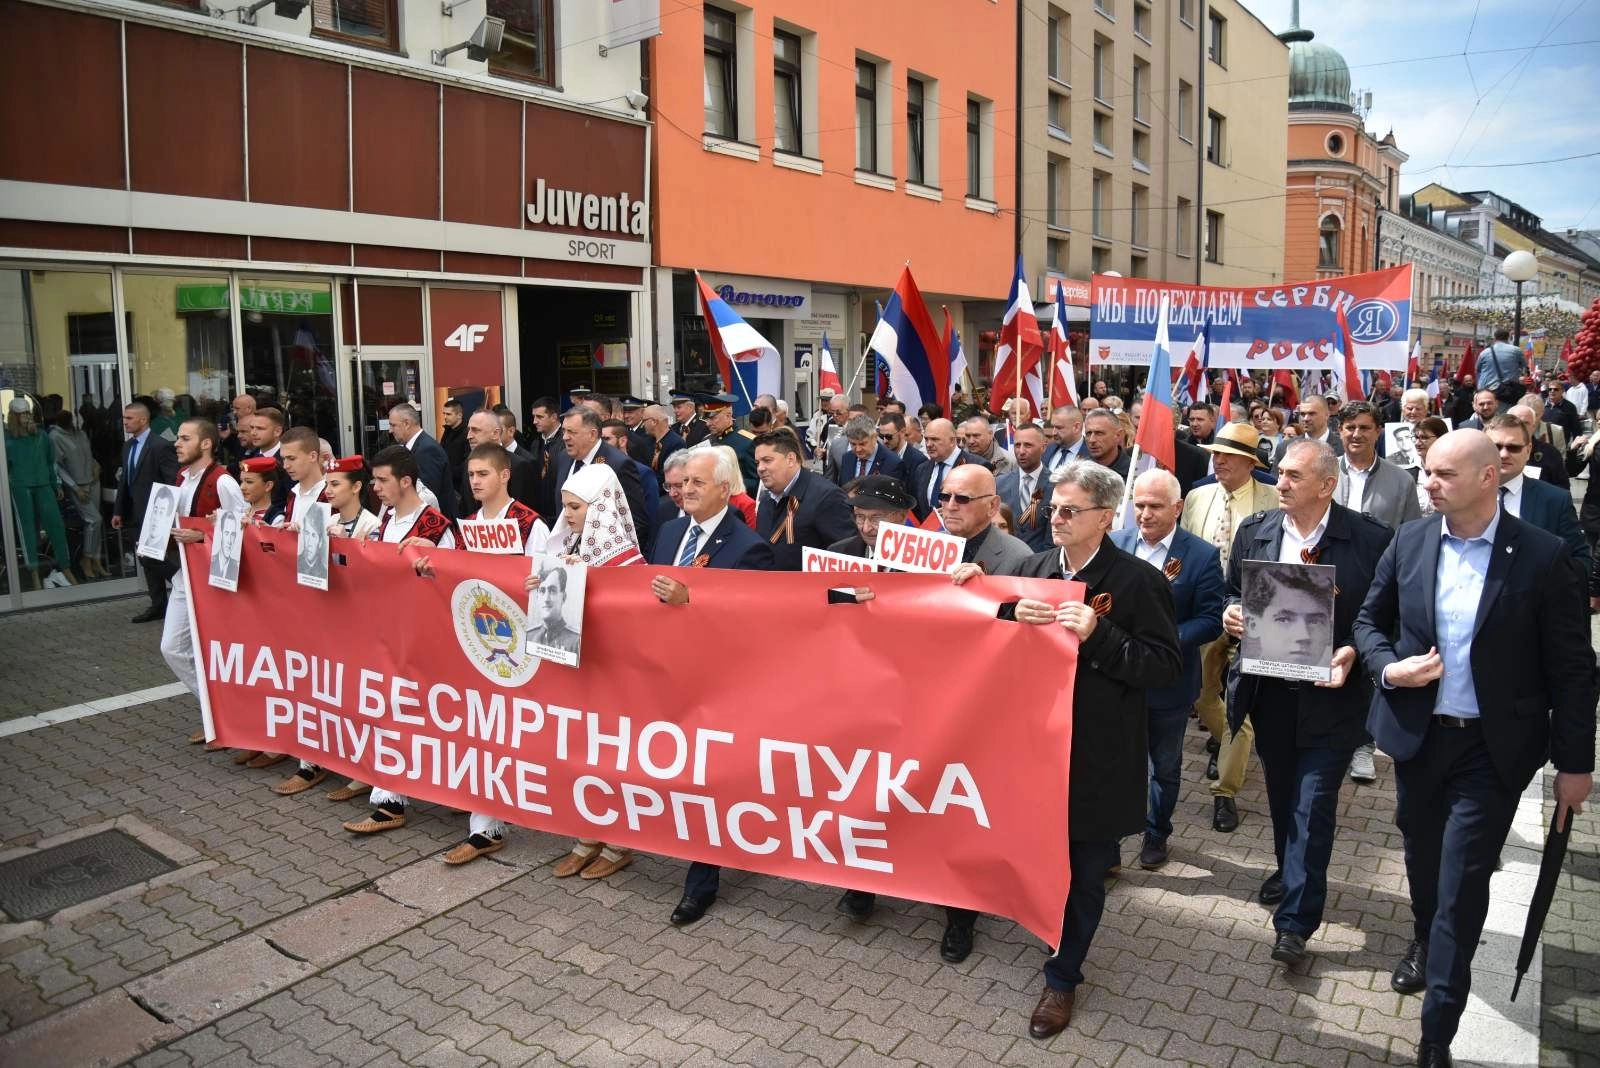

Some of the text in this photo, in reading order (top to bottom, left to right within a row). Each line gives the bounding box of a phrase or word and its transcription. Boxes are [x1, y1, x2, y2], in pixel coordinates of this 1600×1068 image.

[527, 179, 646, 235] Juventa
[568, 239, 616, 260] SPORT
[1096, 287, 1127, 323] МЫ
[444, 323, 489, 352] 4F
[1246, 333, 1336, 361] РОСС
[462, 523, 517, 549] СУБНОР
[881, 528, 959, 571] СУБНОР
[209, 640, 991, 829] МАРШ БЕСМРТНОГ ПУКА
[265, 696, 894, 873] РЕПУБЛИКЕ СРПСКЕ
